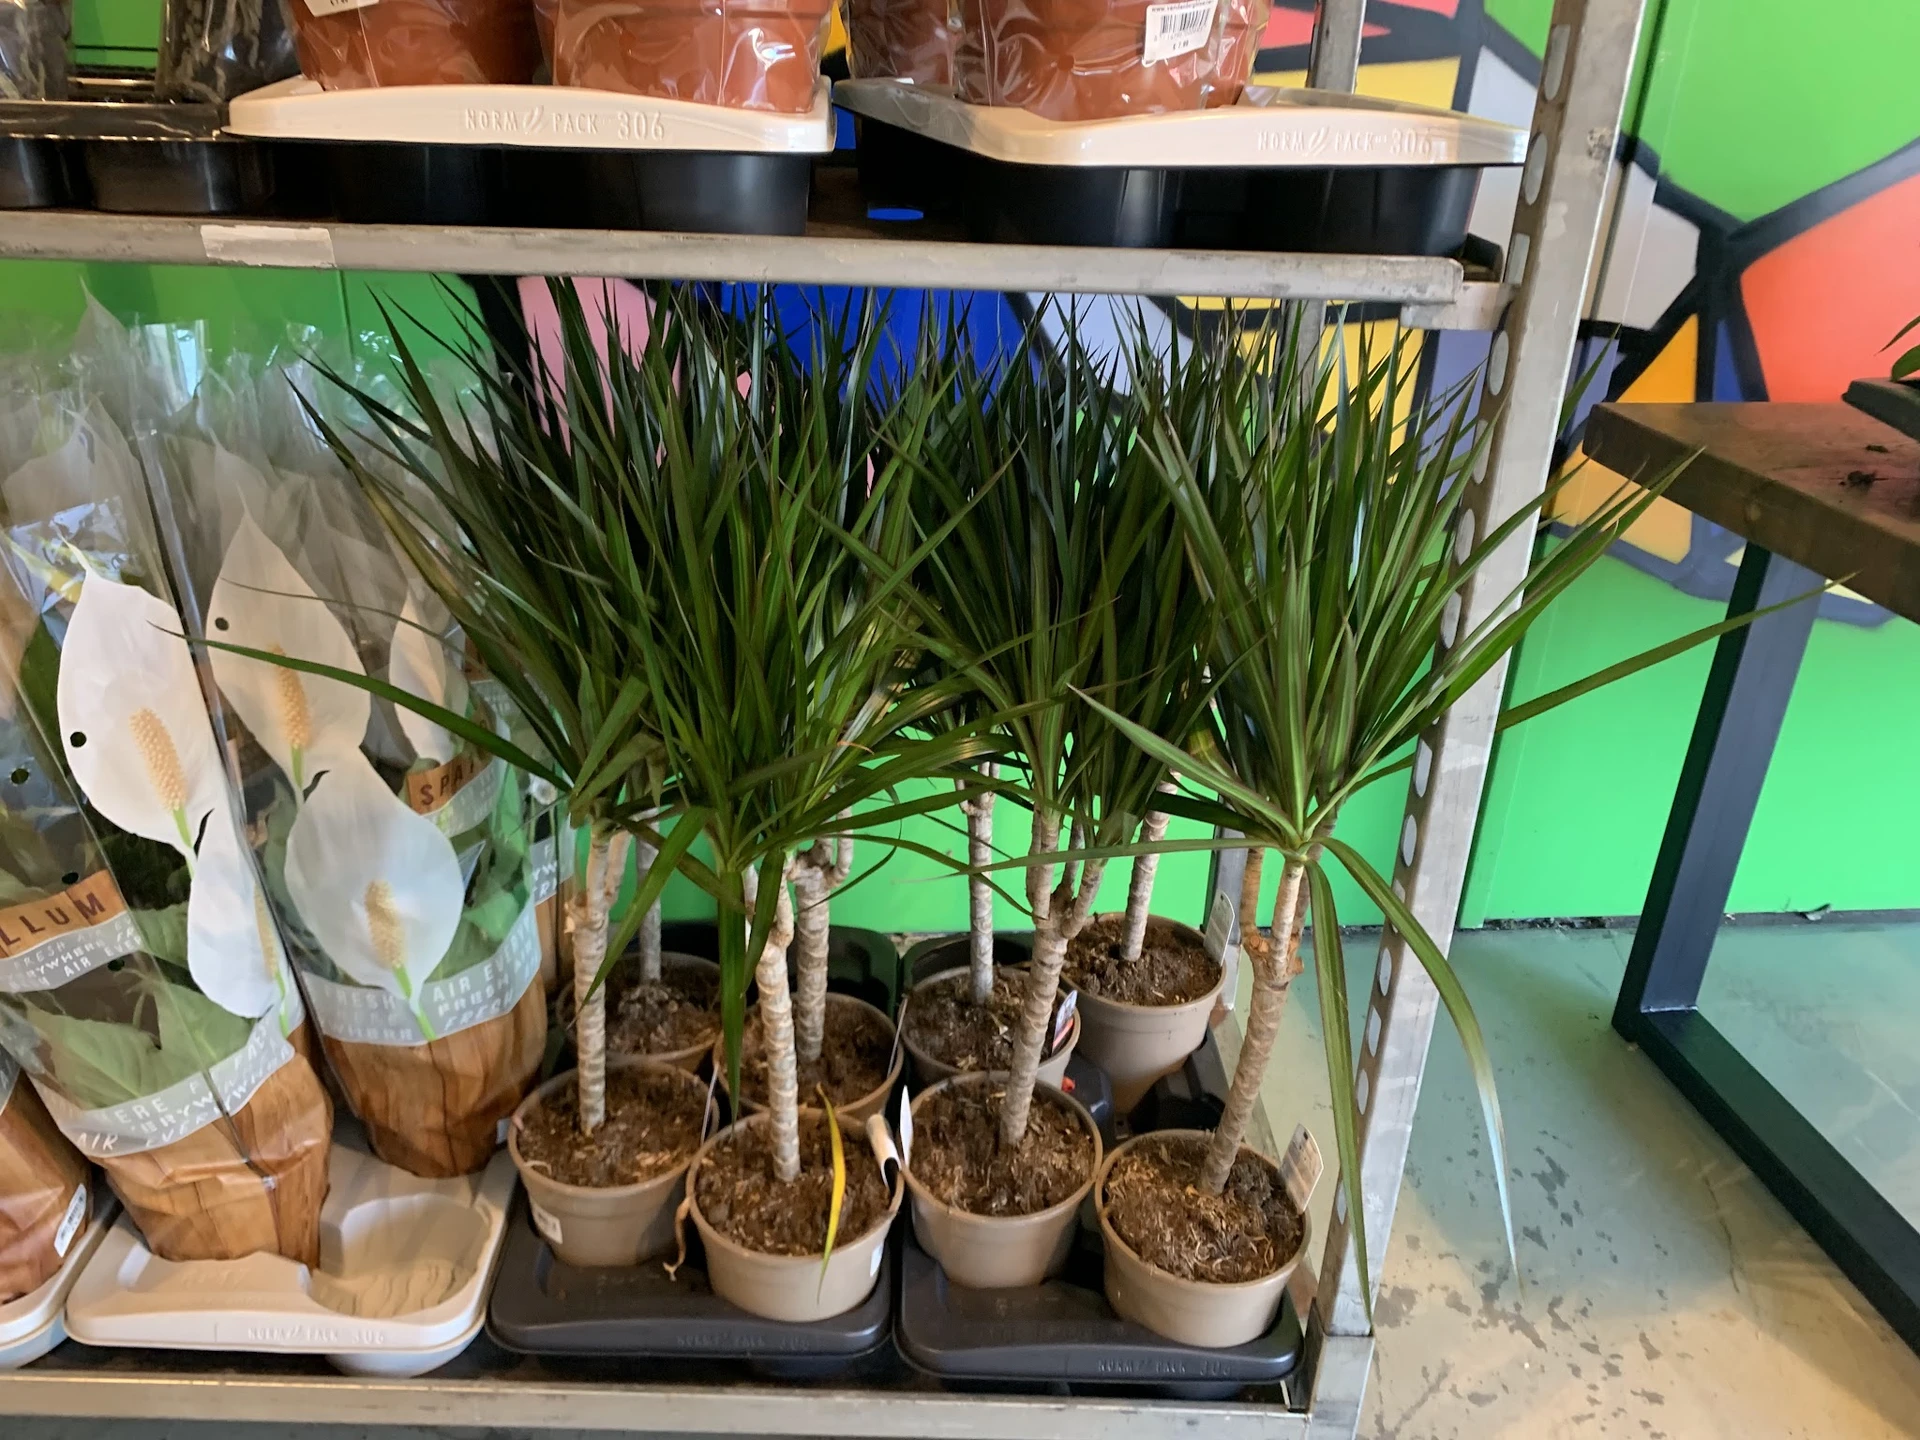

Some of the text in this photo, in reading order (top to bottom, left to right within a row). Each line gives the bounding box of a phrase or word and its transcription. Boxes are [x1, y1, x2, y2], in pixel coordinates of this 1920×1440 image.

[464, 107, 665, 141] NORM PACK 306
[1256, 129, 1305, 152] NORM
[1334, 129, 1376, 153] PACK
[433, 976, 472, 1003] AIR
[76, 1131, 119, 1151] AIR
